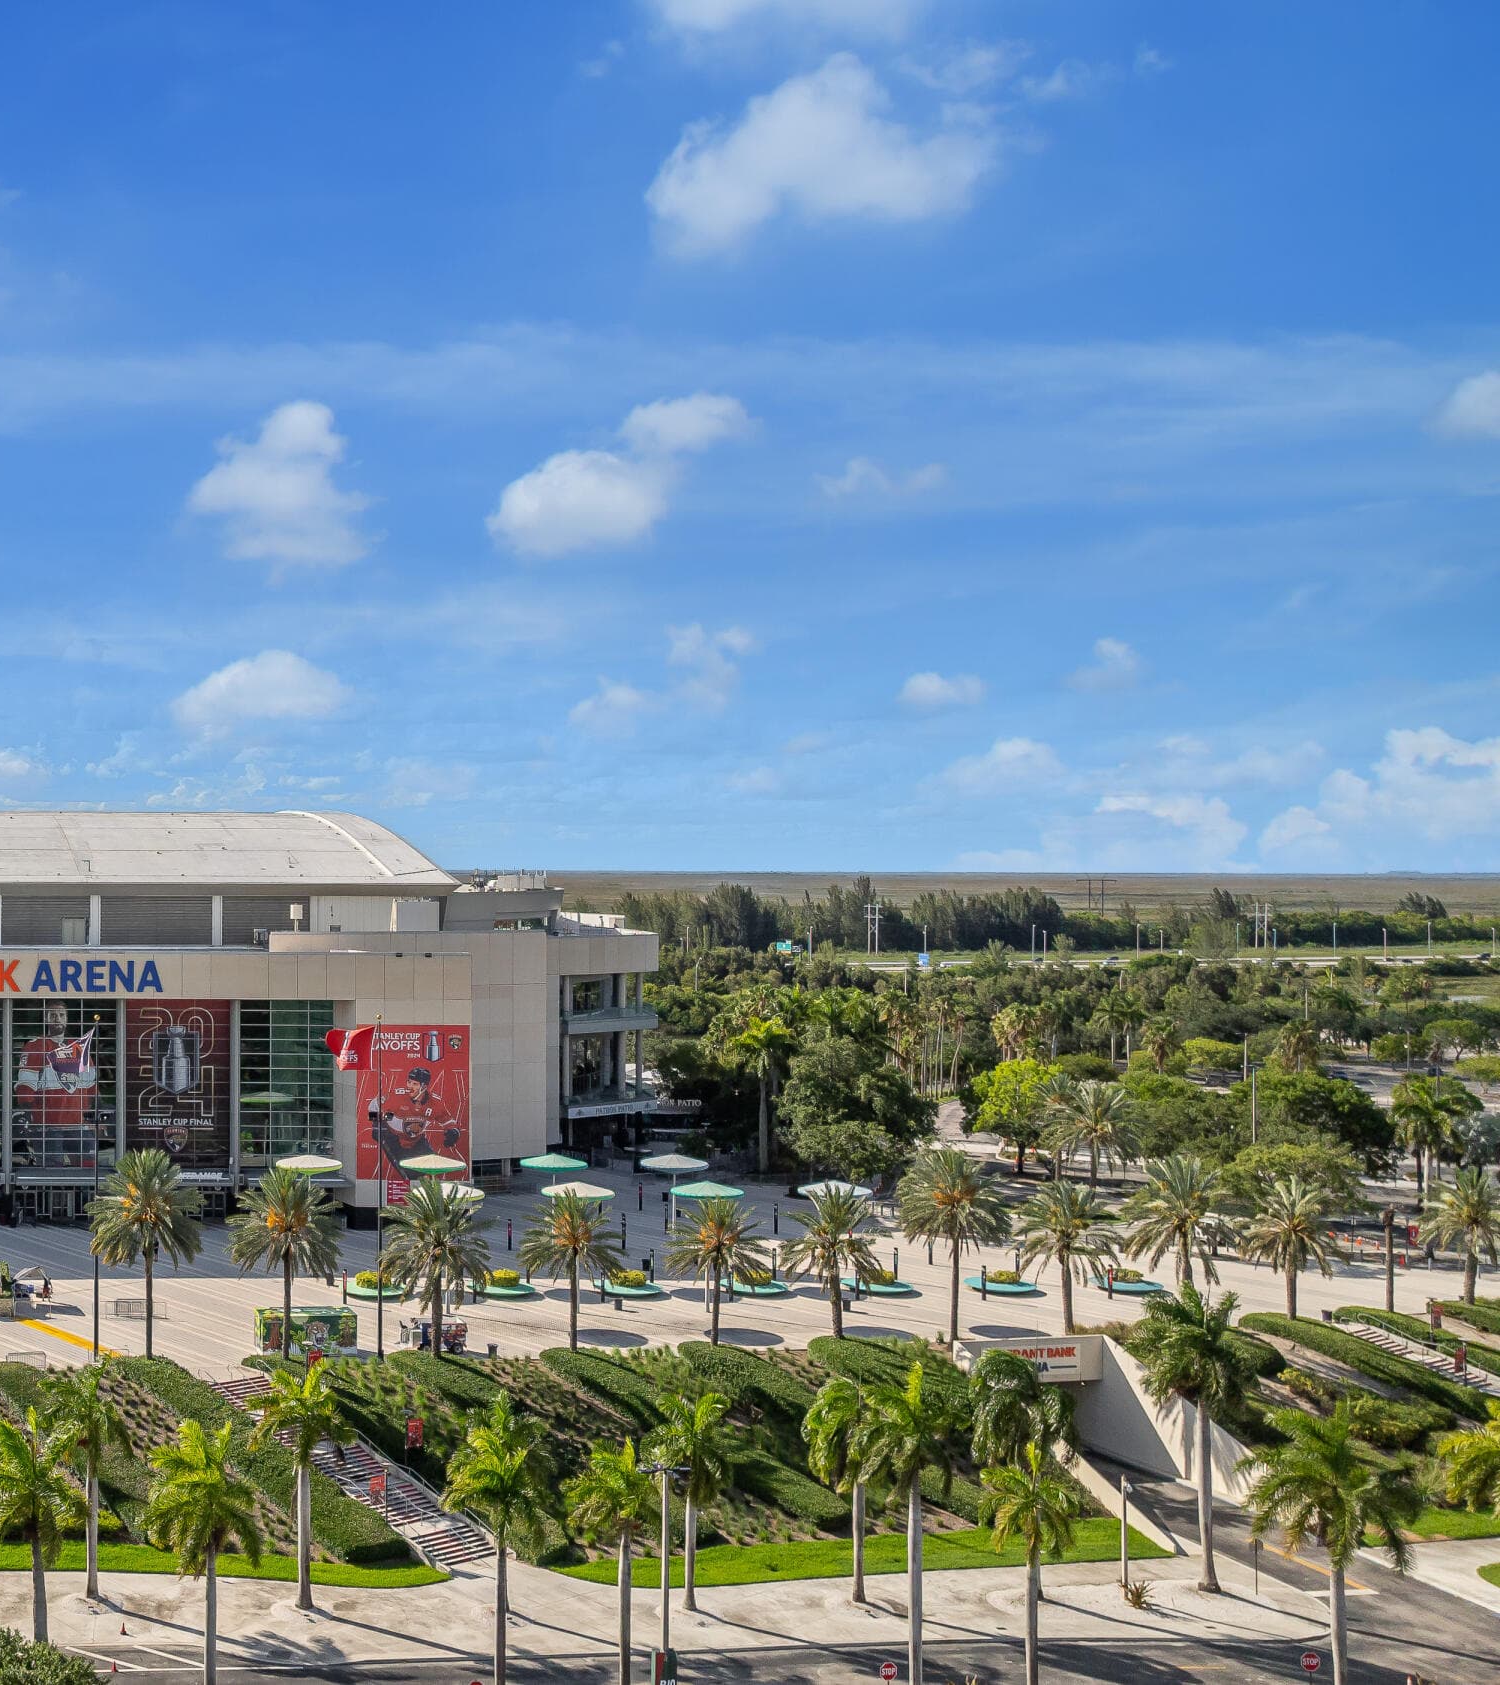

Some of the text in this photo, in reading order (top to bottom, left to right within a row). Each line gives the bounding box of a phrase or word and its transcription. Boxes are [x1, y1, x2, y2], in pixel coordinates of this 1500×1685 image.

[31, 960, 163, 992] ARENA
[374, 1032, 421, 1040] TANLEY CUP
[677, 1099, 702, 1107] PATIO
[138, 1118, 214, 1126] STANLEY CUP FINAL
[1046, 1347, 1076, 1358] BANK
[1302, 1657, 1319, 1666] STOP
[881, 1667, 896, 1676] STOP
